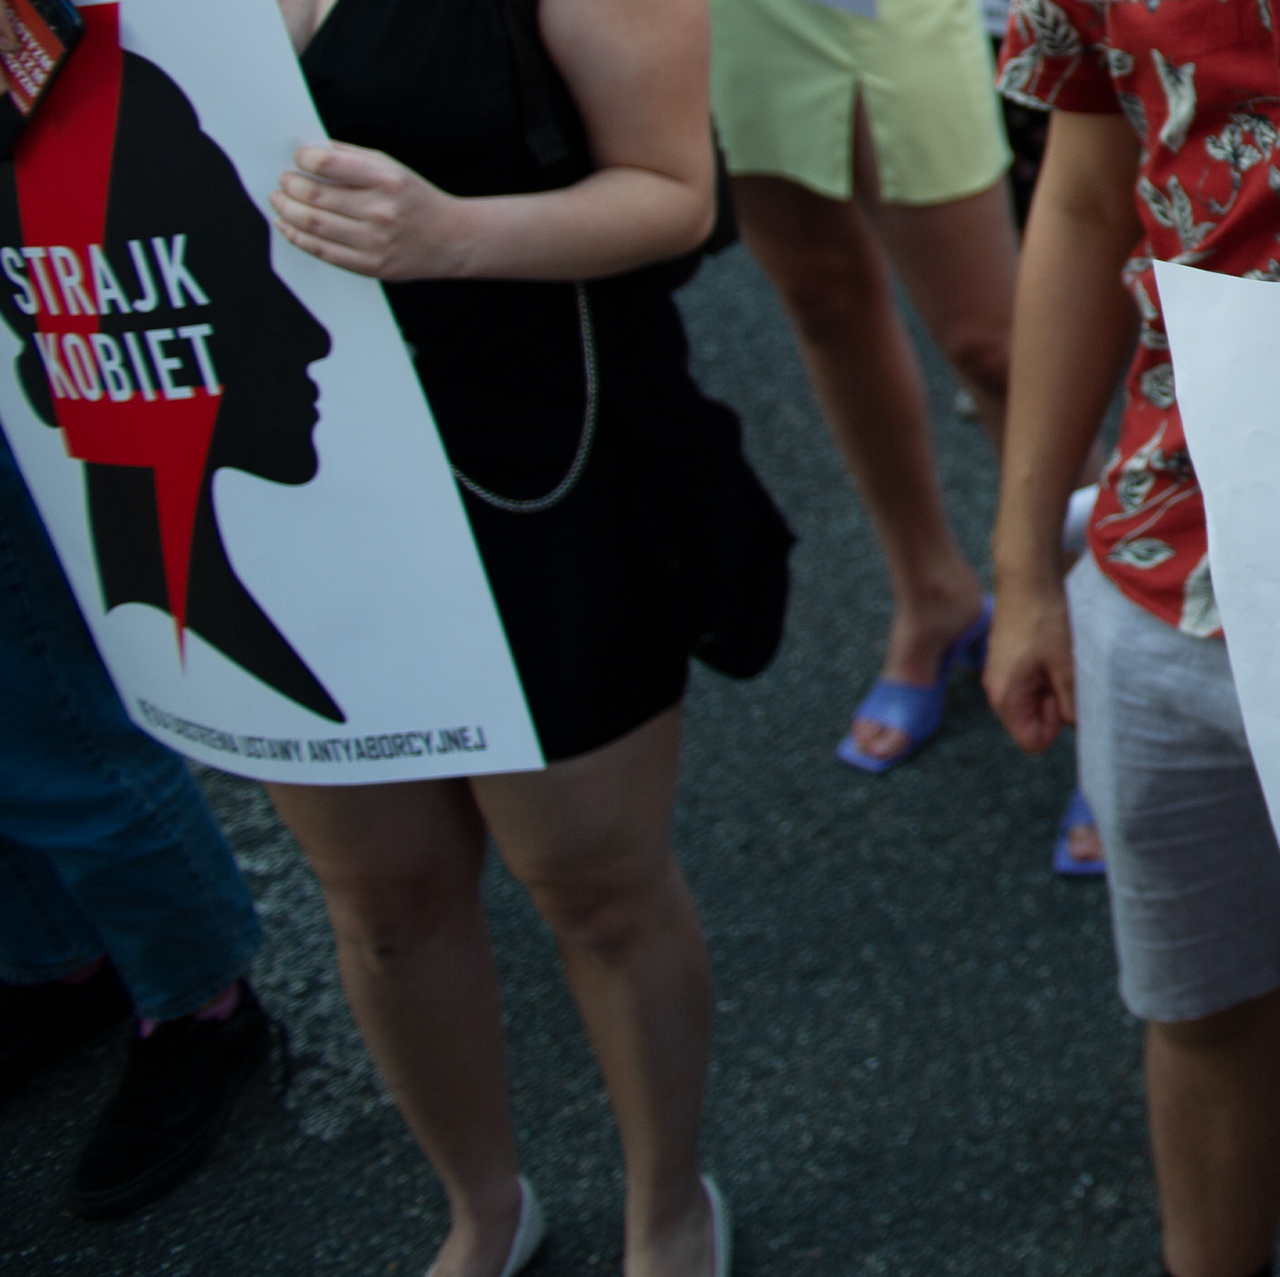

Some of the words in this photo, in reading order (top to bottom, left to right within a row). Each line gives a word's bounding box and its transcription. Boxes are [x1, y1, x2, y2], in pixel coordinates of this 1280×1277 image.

[1, 233, 211, 317] STRAJK
[33, 323, 224, 404] KOBIET
[308, 725, 488, 764] ANTYABORCYJNEJ
